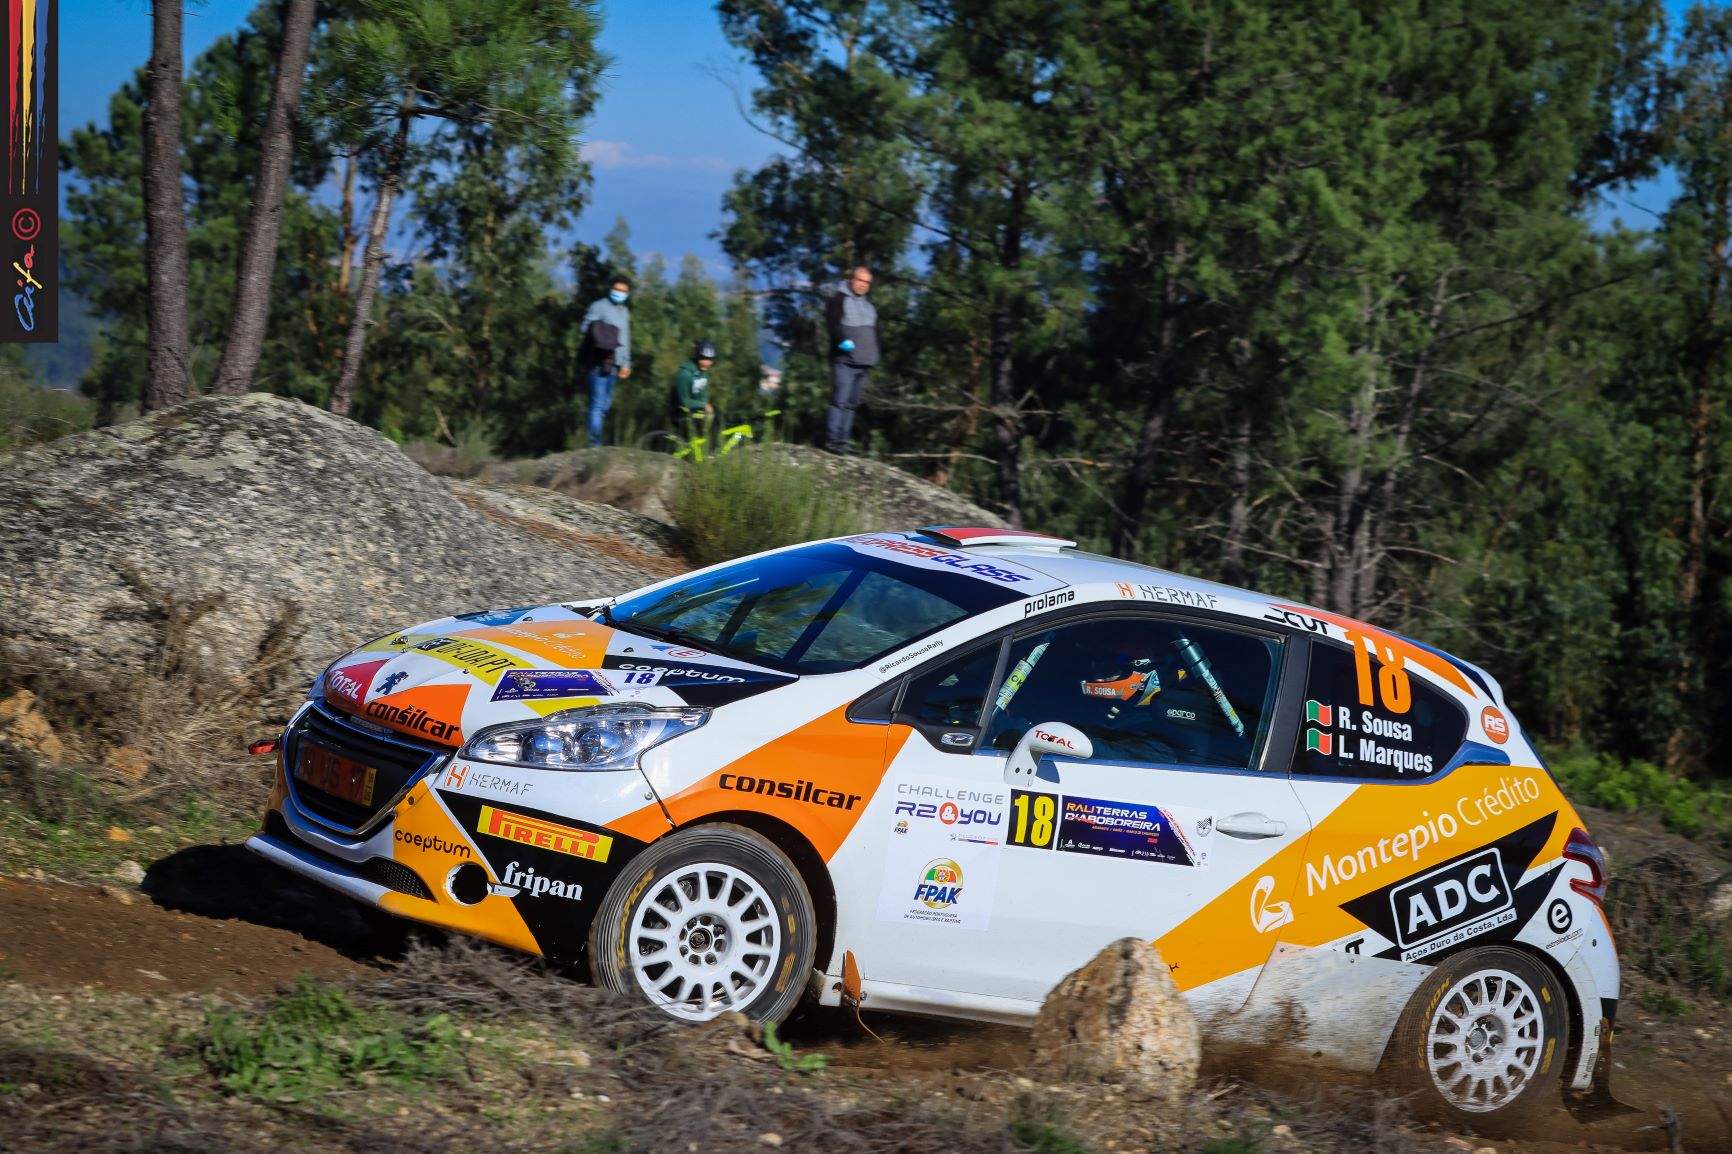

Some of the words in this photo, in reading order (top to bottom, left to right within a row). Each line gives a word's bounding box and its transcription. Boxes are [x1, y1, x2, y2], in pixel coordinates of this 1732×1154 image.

[1024, 590, 1075, 618] prolama
[1139, 584, 1218, 609] HERMAF
[330, 670, 362, 700] TOTAL
[623, 672, 656, 685] 18
[1343, 629, 1412, 714] 18
[1095, 688, 1116, 696] SOUSA
[366, 701, 460, 741] consilcar
[1166, 708, 1196, 719] sparco
[1338, 706, 1357, 731] R.
[1362, 711, 1413, 742] Sousa
[1484, 714, 1506, 733] RS
[1035, 729, 1075, 750] TOTAL
[1338, 735, 1354, 760] L.
[1360, 739, 1433, 774] Marques
[469, 772, 534, 796] HERMAF
[719, 773, 862, 811] consilcar
[897, 783, 1005, 805] CHALLENGE
[488, 808, 600, 859] PIRELLI
[1013, 793, 1055, 847] 18
[394, 830, 471, 859] coeptum
[1305, 810, 1458, 897] Montepio
[1457, 776, 1540, 826] Crédito
[502, 861, 583, 901] fripan
[913, 883, 964, 905] FPAK
[1407, 863, 1501, 935] ADC
[1405, 948, 1427, 962] Aços
[1430, 938, 1451, 952] Duro
[1453, 931, 1464, 941] da
[1466, 921, 1495, 936] Costa,
[1497, 912, 1514, 927] Lda
